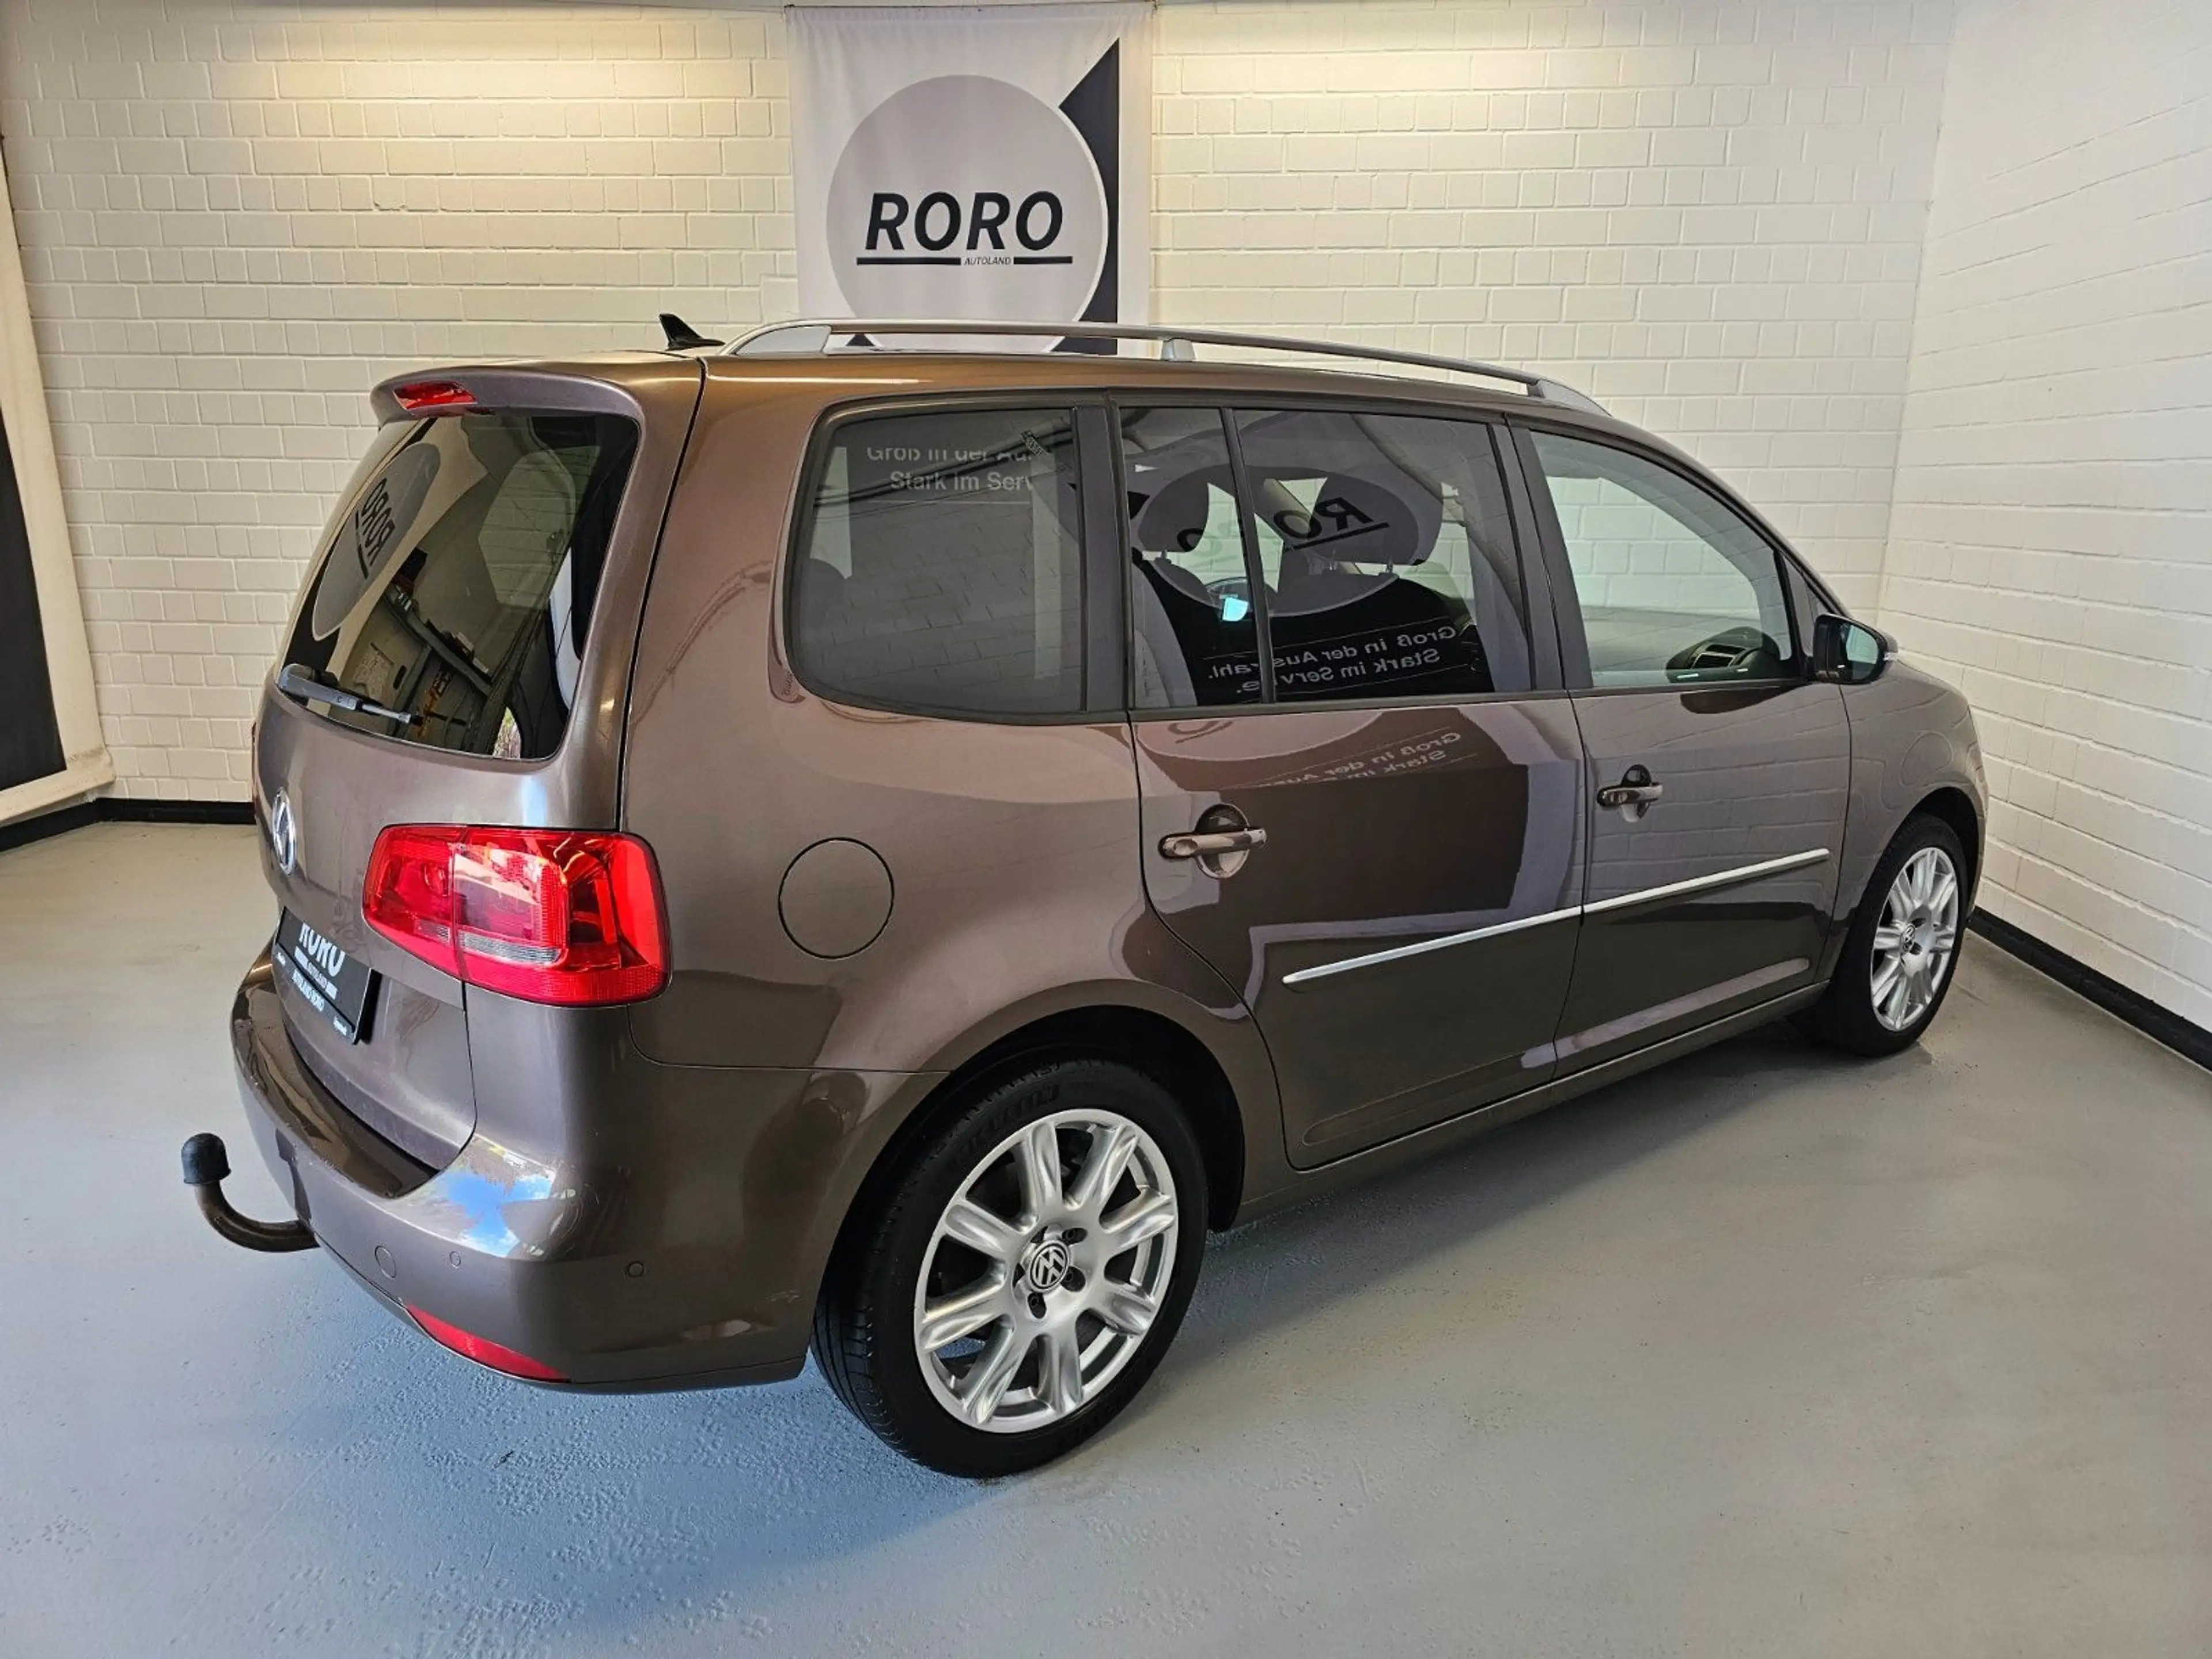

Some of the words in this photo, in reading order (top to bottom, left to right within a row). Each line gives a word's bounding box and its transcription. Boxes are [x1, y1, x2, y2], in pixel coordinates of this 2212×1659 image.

[865, 191, 1063, 251] RORO
[964, 256, 1012, 265] AUTOLAND
[890, 471, 947, 491] Stark
[954, 474, 979, 491] im
